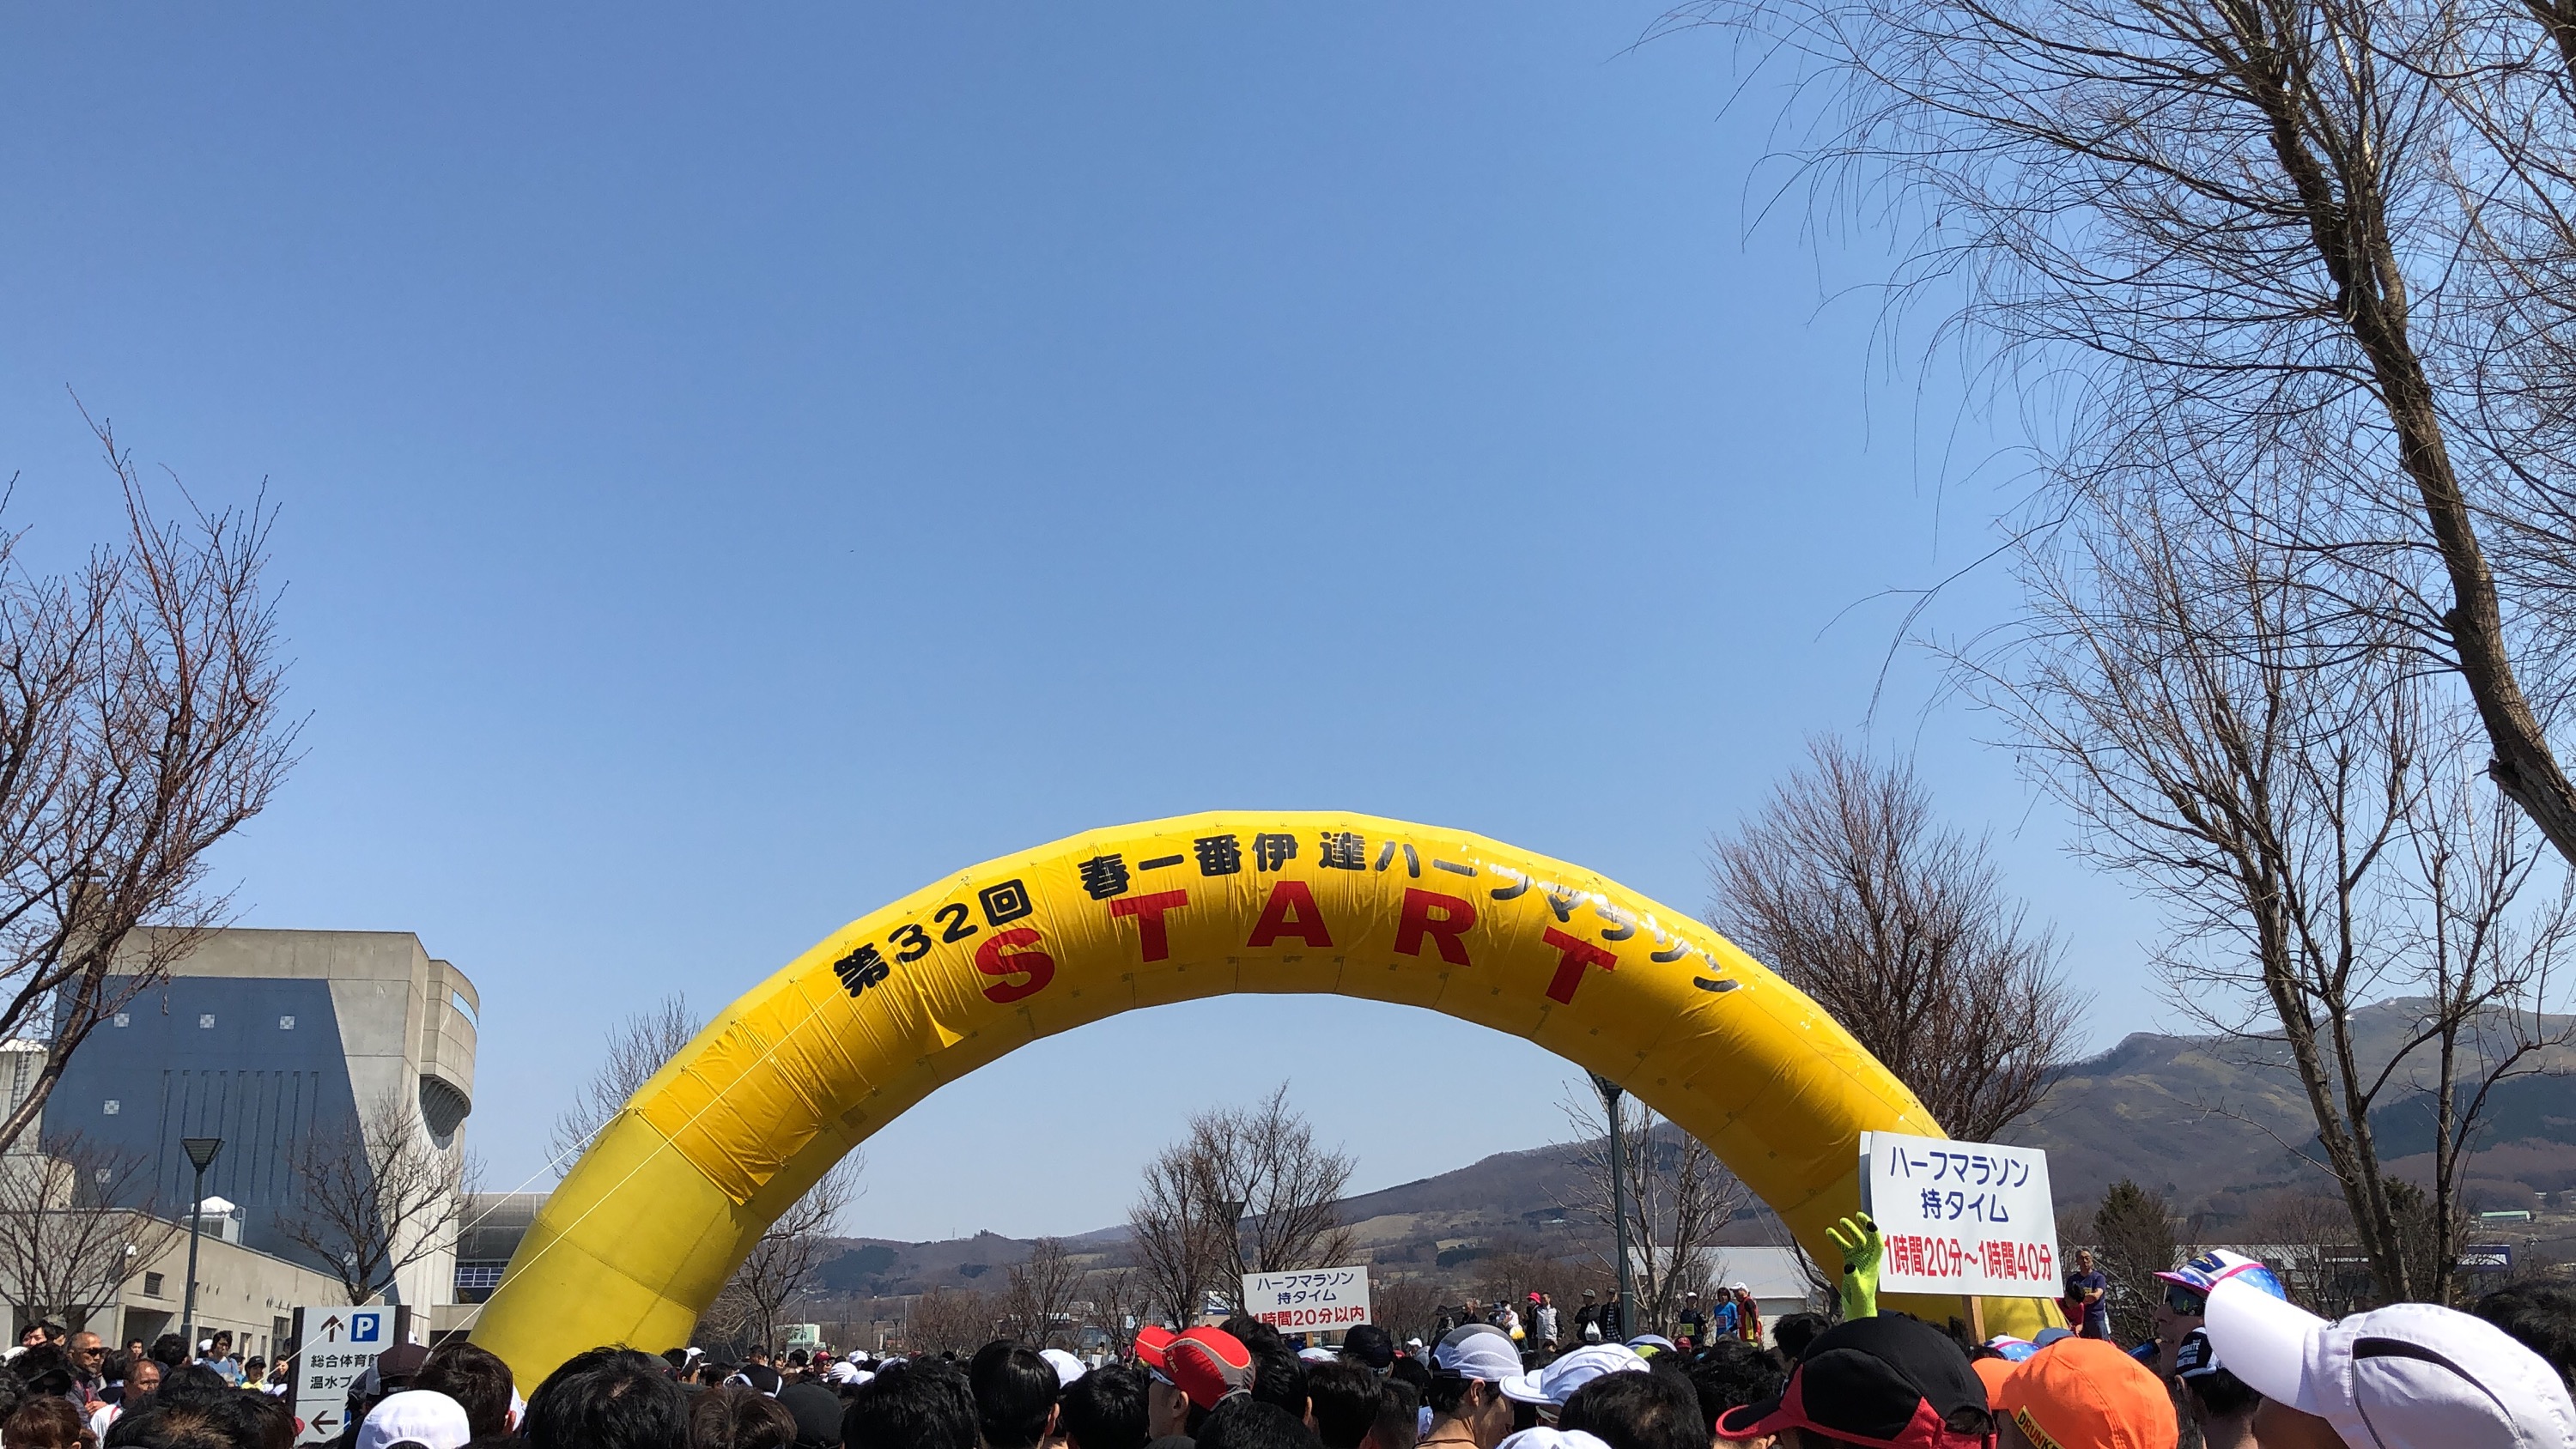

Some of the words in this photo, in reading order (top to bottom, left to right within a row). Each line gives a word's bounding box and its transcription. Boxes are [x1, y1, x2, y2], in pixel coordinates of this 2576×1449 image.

[833, 878, 1032, 998] 第32回
[975, 881, 1618, 1004] START
[1890, 1146, 2029, 1187] ハーフマラソン
[1921, 1187, 2009, 1222] 持タイム
[1257, 1272, 1354, 1291] ハーフマラソン
[1277, 1288, 1337, 1305] 持タイム
[355, 1316, 374, 1338] P
[2018, 1410, 2059, 1449] DRUNK
